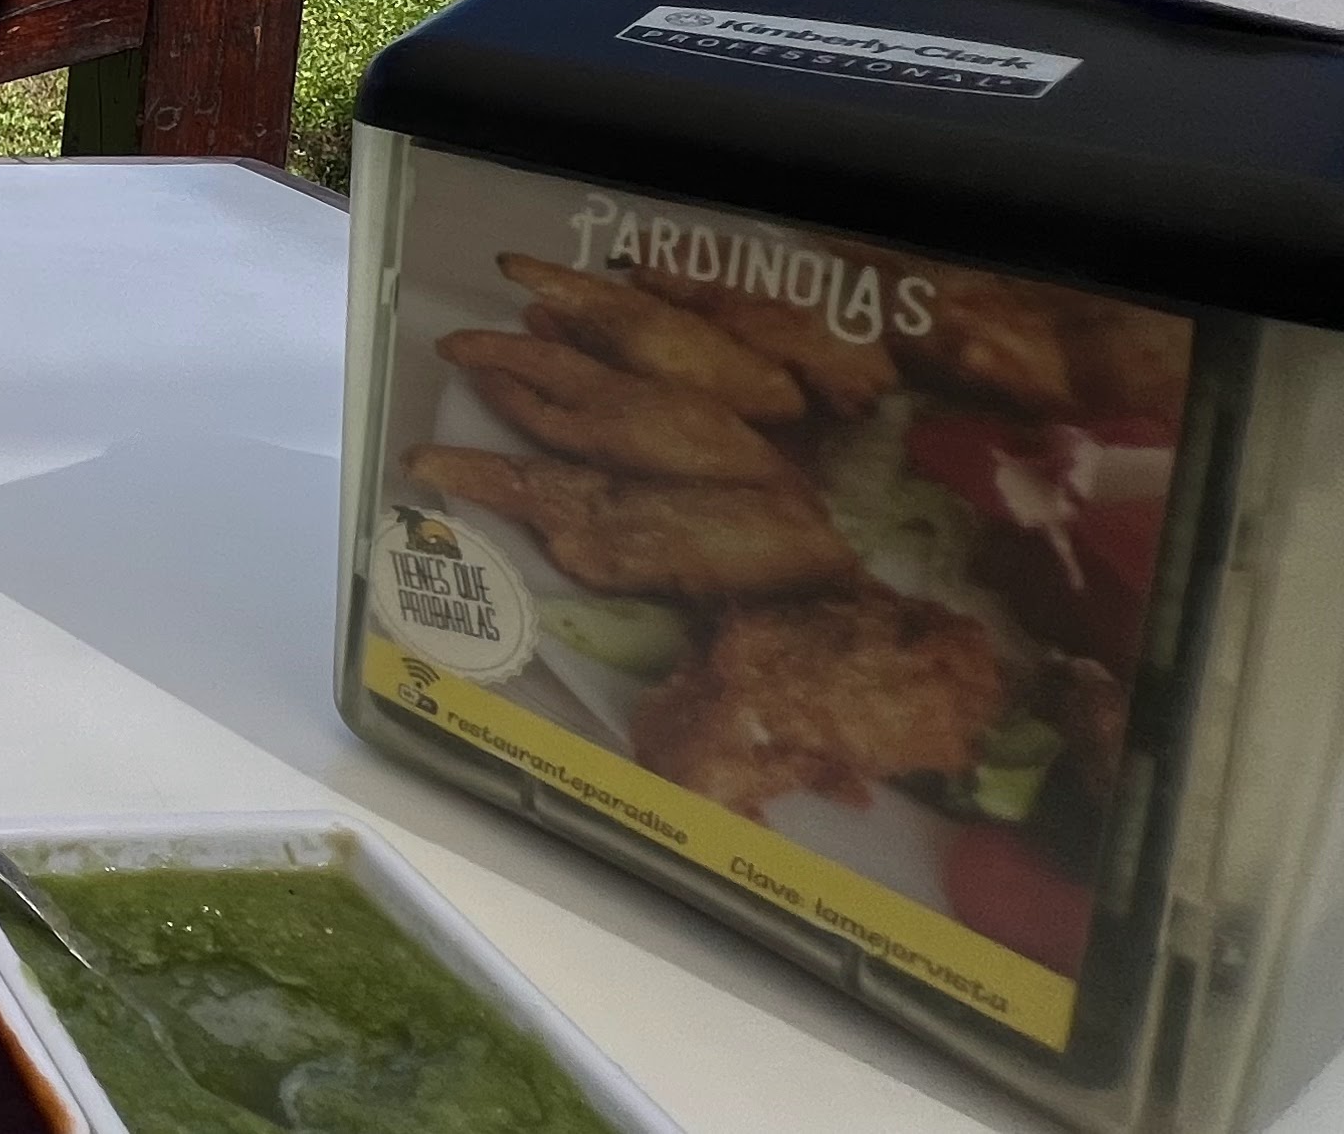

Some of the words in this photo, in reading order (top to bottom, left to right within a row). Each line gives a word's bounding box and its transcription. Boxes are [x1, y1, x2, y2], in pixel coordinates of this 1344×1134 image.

[641, 29, 999, 87] PROFESSIONAL
[716, 17, 1034, 71] Kimberly-Clark
[389, 550, 451, 597] TIENES
[453, 561, 494, 606] QUE
[398, 588, 501, 643] PROBARLAS
[447, 708, 689, 846] restauranteparadise
